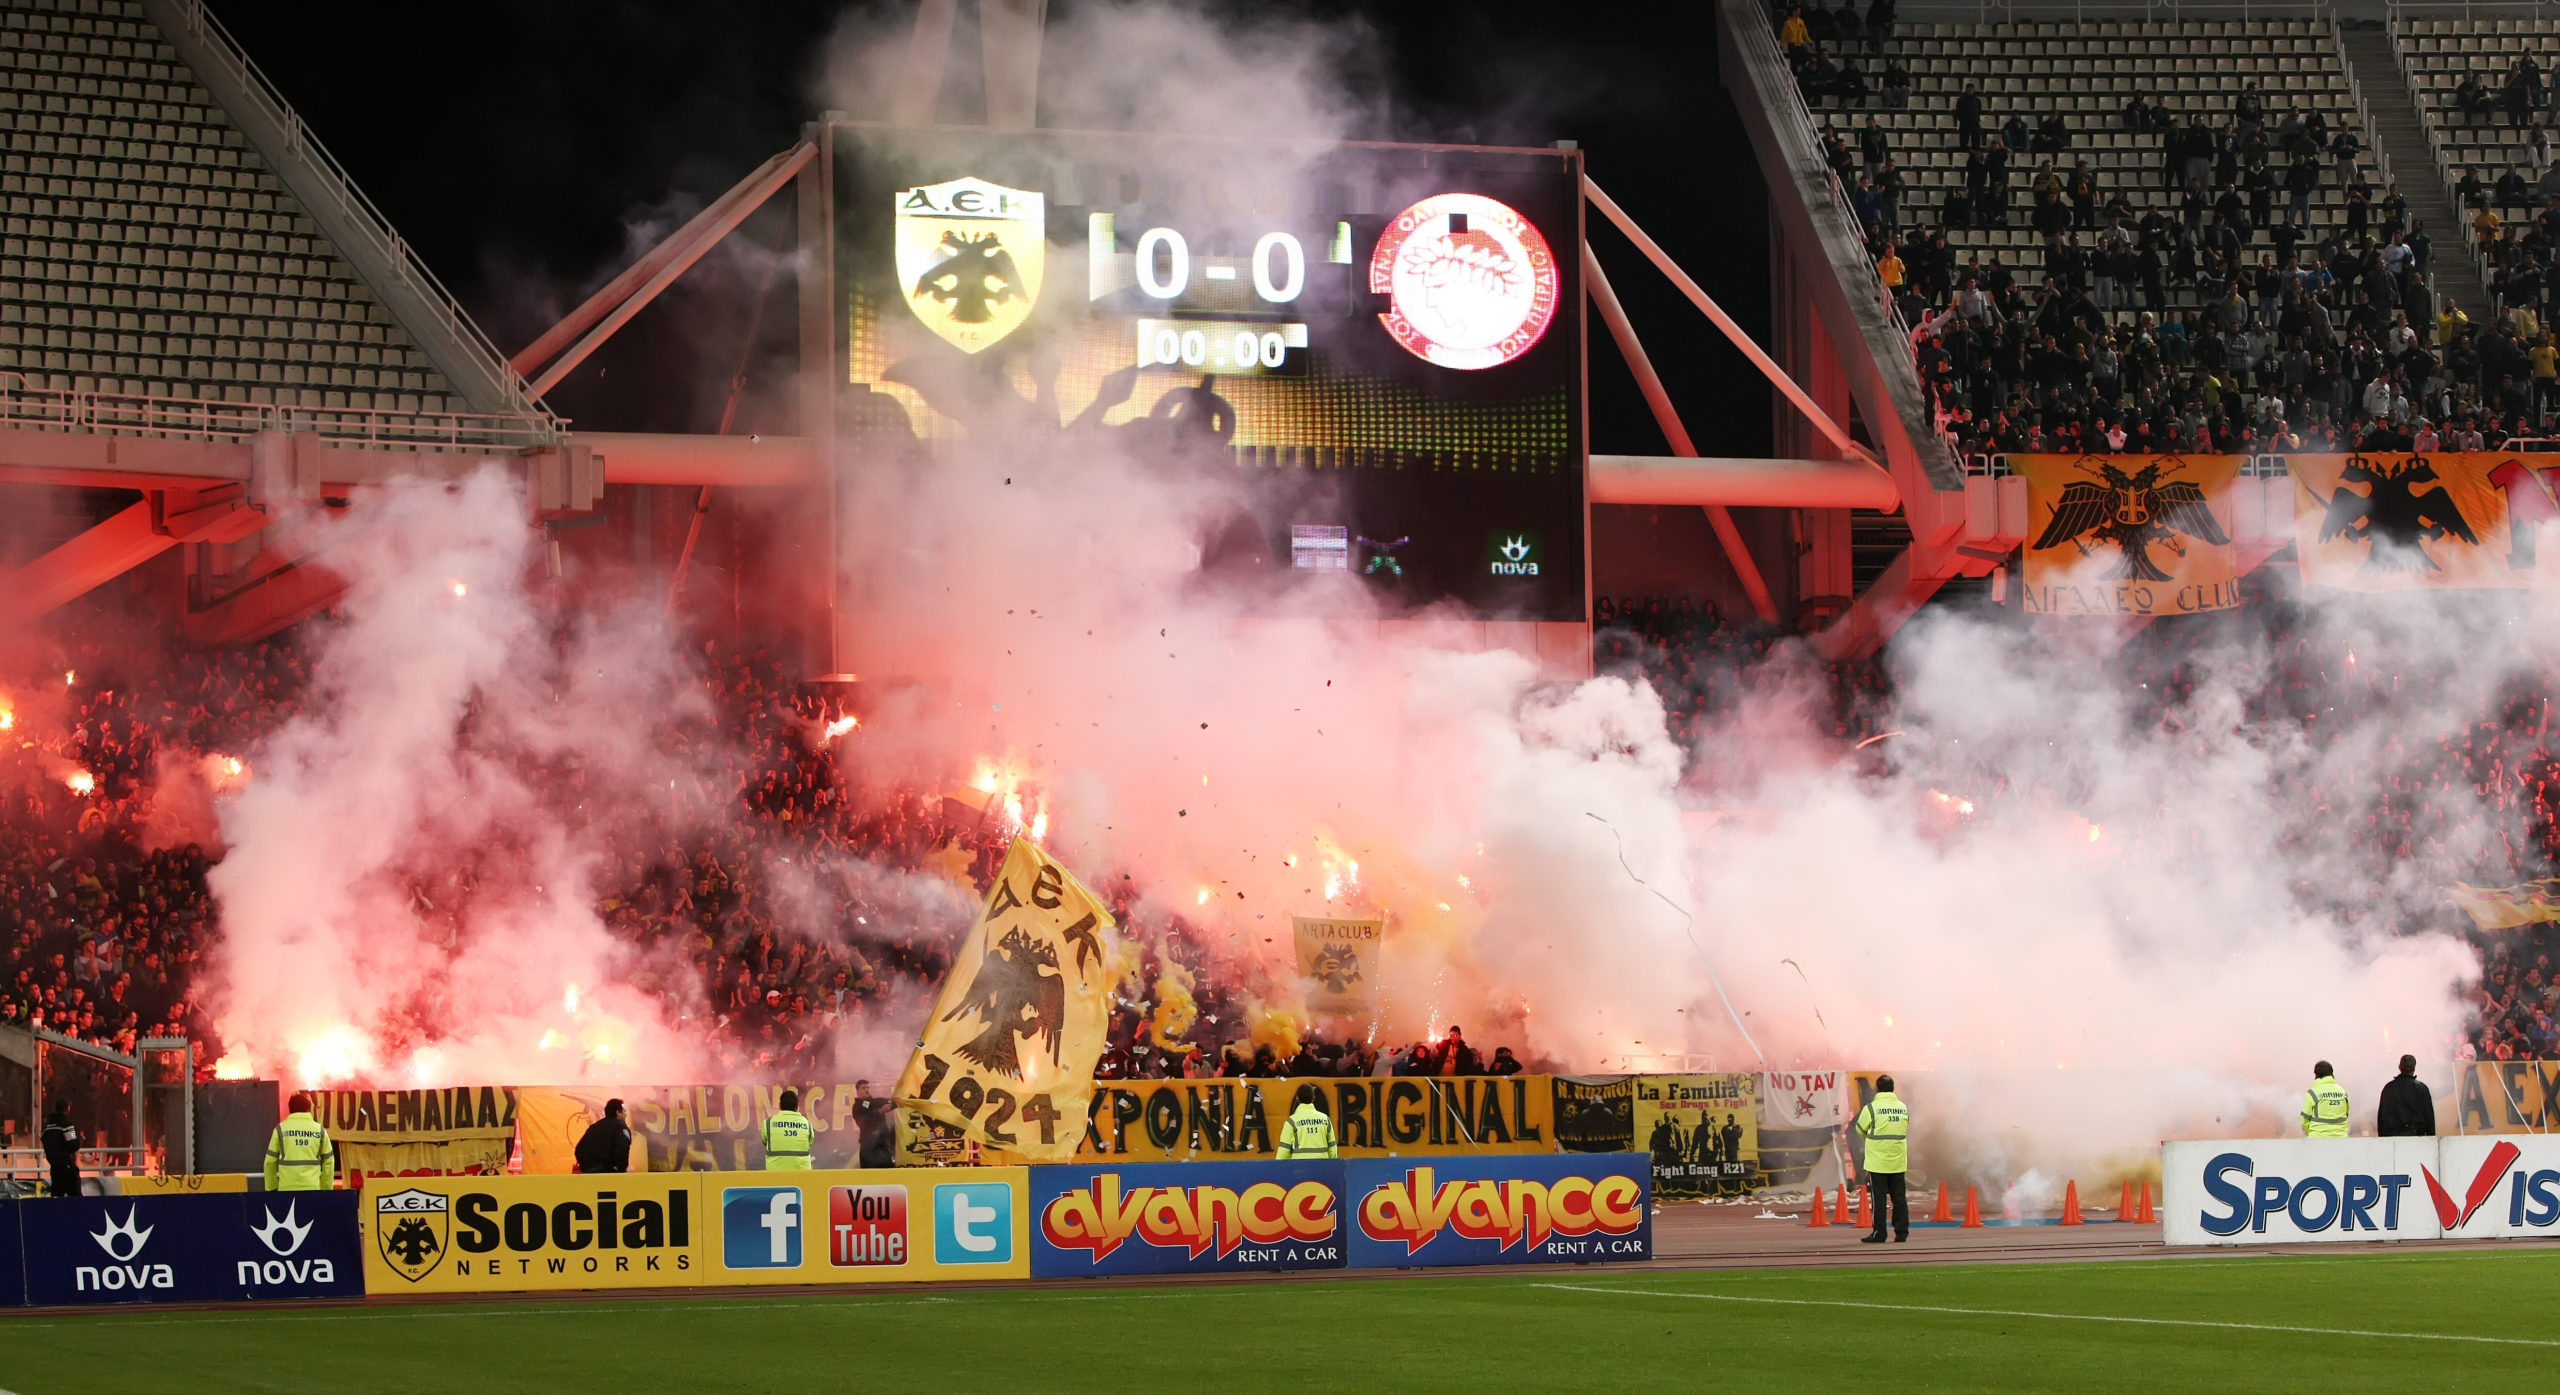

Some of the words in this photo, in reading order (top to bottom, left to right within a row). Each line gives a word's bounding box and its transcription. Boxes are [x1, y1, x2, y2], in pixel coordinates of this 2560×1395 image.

[1154, 329, 1287, 368] 00:00
[1491, 561, 1539, 576] nova
[1302, 923, 1335, 939] ARTA
[1338, 925, 1372, 940] CLUB
[1637, 1084, 1660, 1100] La
[1668, 1080, 1739, 1100] Familia
[1769, 1072, 1796, 1091] NO
[1801, 1072, 1836, 1092] TAV
[311, 1086, 519, 1132] ΤΟΛΕΜΑΙΔΑΣ
[638, 1083, 862, 1136] SALONCA
[908, 1053, 1062, 1145] 1924
[1660, 1101, 1677, 1109] Sex
[1681, 1100, 1710, 1110] Drugs
[289, 1130, 321, 1139] BRINKS
[777, 1121, 808, 1130] BRINKS
[1652, 1164, 1685, 1180] Fight
[1688, 1163, 1719, 1178] Gang
[1723, 1162, 1745, 1174] R21
[847, 1189, 890, 1221] You
[455, 1189, 689, 1254] Social
[761, 1192, 797, 1263] f
[953, 1192, 997, 1252] t
[834, 1224, 904, 1262] Tube
[1238, 1248, 1280, 1263] RENT
[1286, 1248, 1298, 1261] A
[1304, 1247, 1338, 1261] CAR
[1547, 1242, 1588, 1255] RENT
[1594, 1242, 1606, 1254] A
[1611, 1240, 1643, 1253] CAR
[75, 1264, 174, 1291] nova
[237, 1258, 335, 1285] nova
[457, 1255, 690, 1276] NETWORKS
